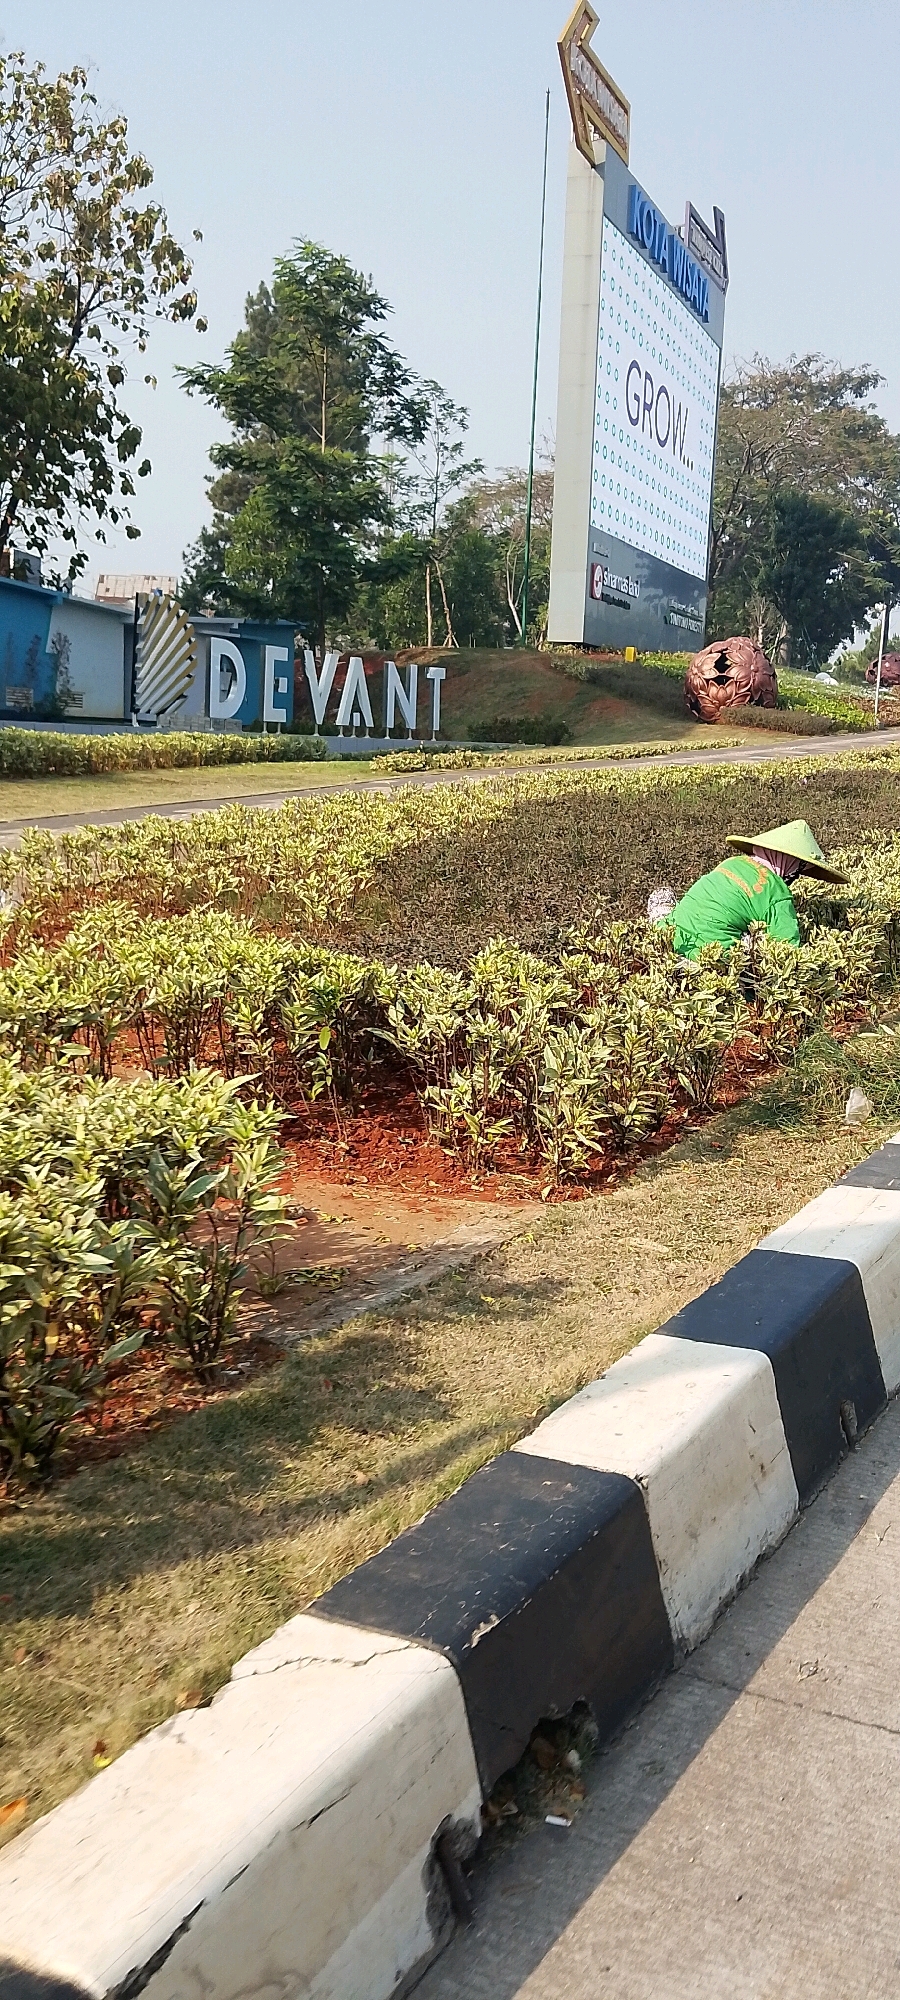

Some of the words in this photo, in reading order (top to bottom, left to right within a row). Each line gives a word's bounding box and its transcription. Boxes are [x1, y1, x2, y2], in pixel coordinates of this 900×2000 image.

[627, 184, 669, 273] KOTA
[668, 234, 710, 323] WISATA
[208, 636, 447, 732] DEVANT
